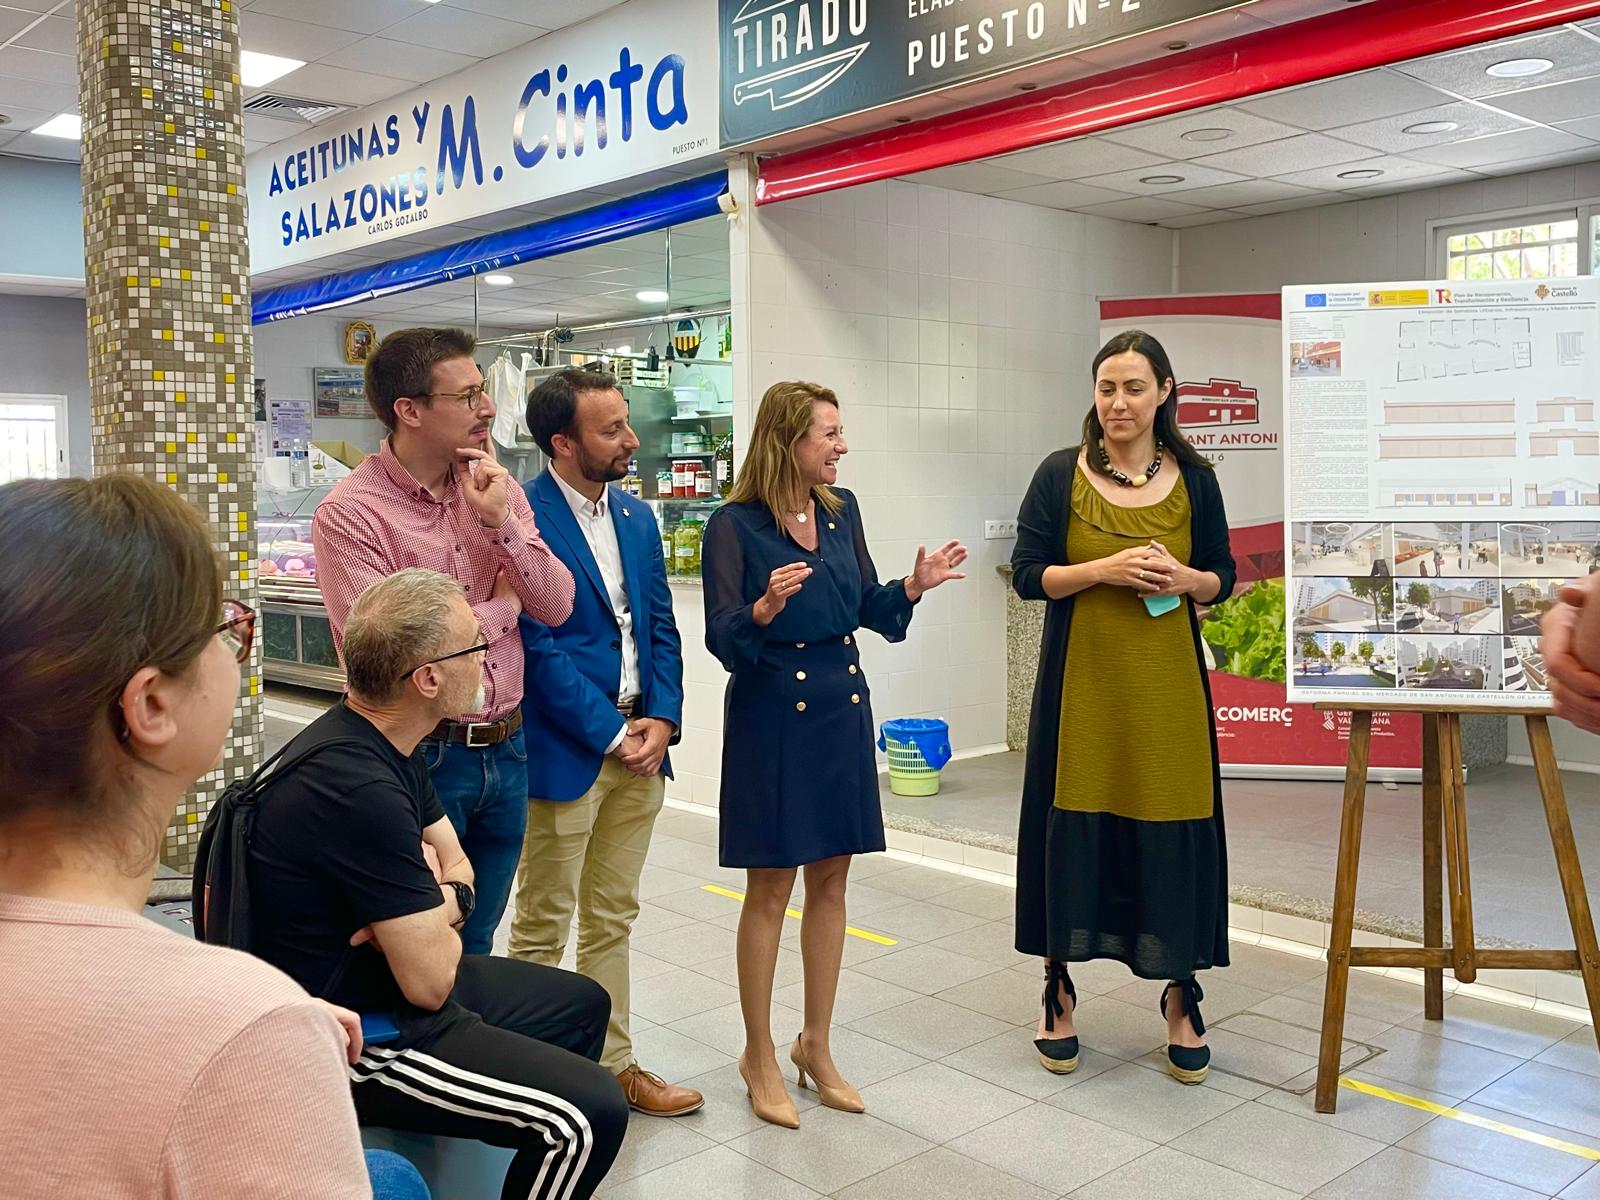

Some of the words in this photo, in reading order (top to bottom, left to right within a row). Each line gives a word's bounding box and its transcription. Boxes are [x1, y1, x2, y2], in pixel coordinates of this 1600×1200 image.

[733, 0, 867, 74] TIRADO
[908, 2, 1045, 76] PUESTO
[269, 115, 400, 197] ACEITUNAS
[412, 102, 430, 144] Y
[434, 95, 503, 195] M.
[513, 47, 688, 169] Cinta
[672, 141, 696, 156] PUESTO
[281, 166, 429, 246] SALAZONES
[368, 220, 393, 235] CARLOS
[395, 209, 429, 226] GOZALBO
[1187, 434, 1216, 445] ANT
[1220, 433, 1278, 445] ANTONI
[1216, 706, 1293, 727] COMERÇ
